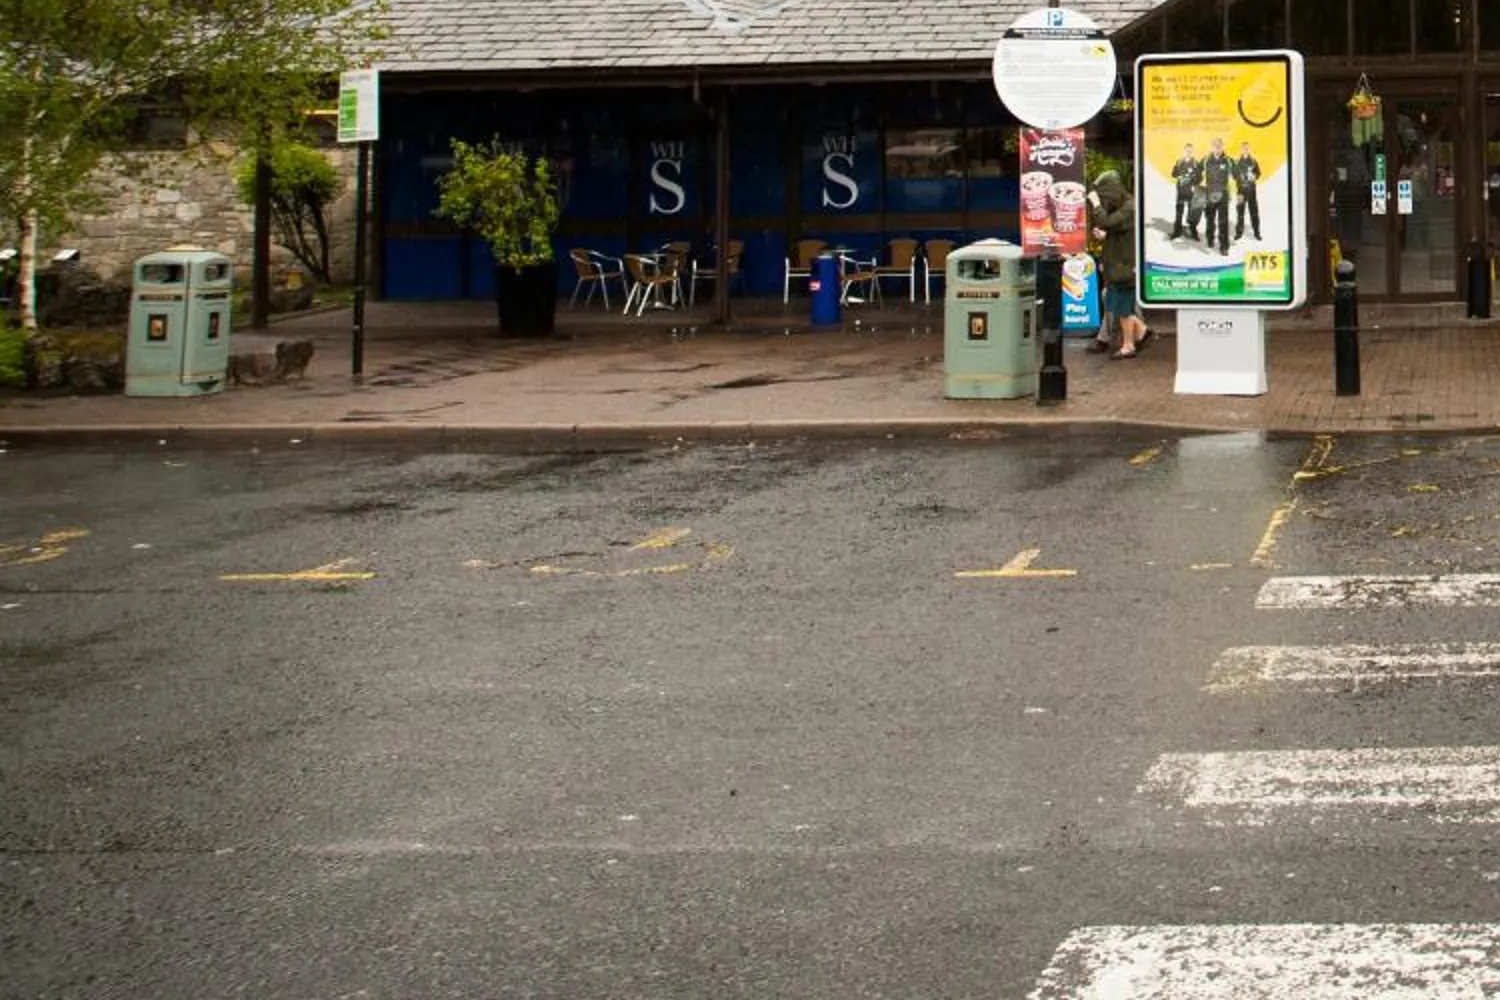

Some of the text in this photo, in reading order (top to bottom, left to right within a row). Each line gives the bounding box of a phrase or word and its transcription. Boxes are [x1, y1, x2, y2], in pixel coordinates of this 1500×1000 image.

[649, 158, 686, 214] S
[822, 152, 859, 209] S
[1249, 255, 1278, 271] ATS
